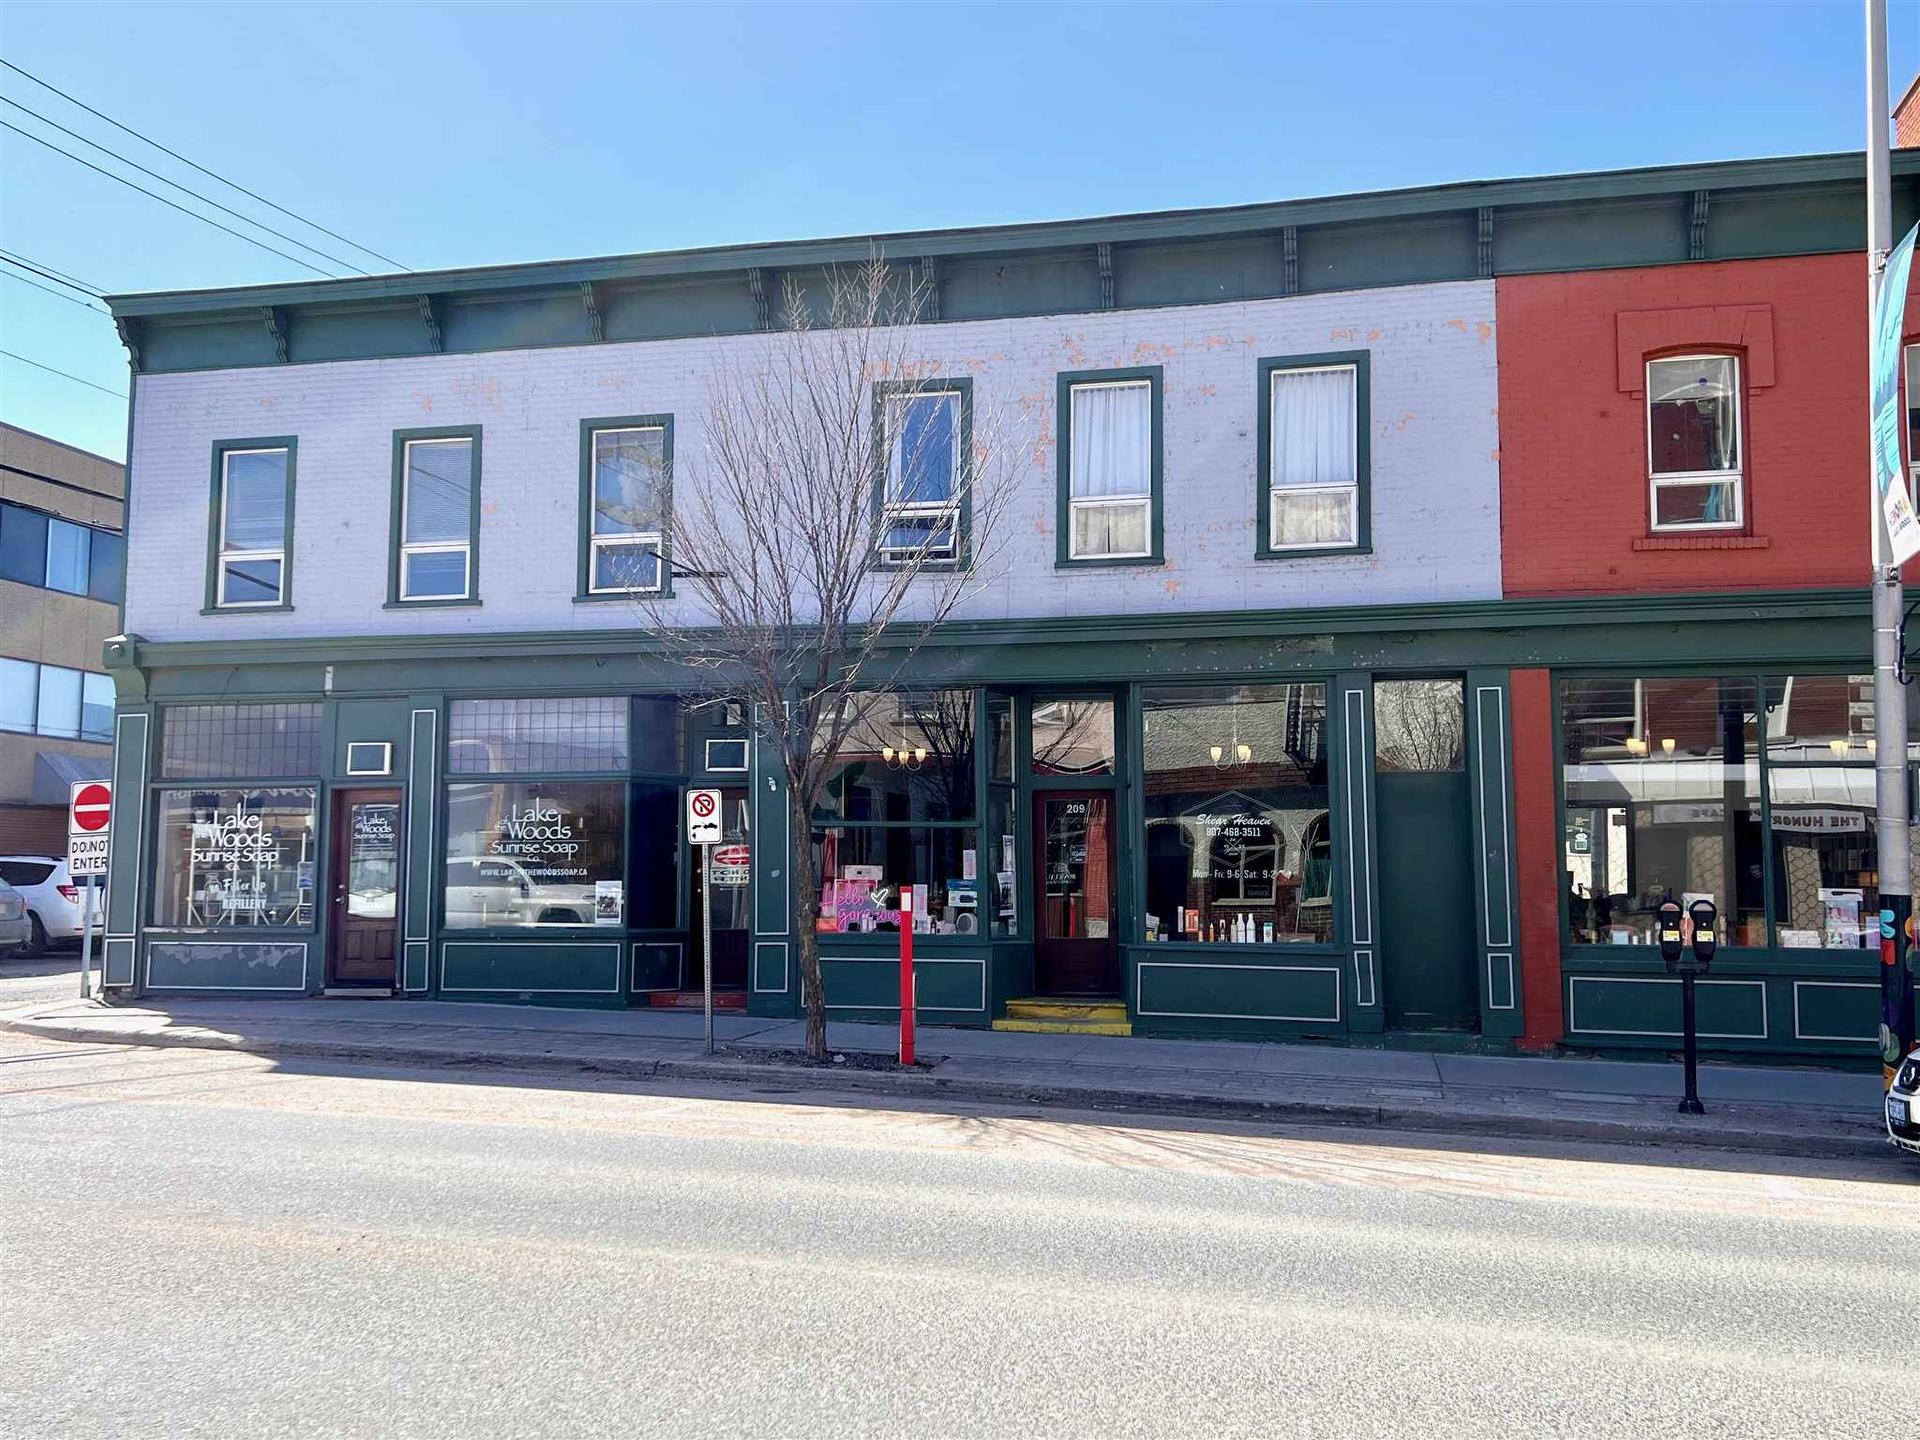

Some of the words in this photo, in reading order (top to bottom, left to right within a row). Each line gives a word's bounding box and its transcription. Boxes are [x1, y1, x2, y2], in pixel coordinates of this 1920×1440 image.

[213, 802, 260, 829] Lake
[513, 796, 559, 822] Lake
[1066, 804, 1086, 814] 209
[507, 814, 572, 840] Woods
[1230, 813, 1272, 826] Heaven
[209, 820, 273, 848] Woods
[1206, 827, 1261, 837] 807-468-3511
[72, 841, 87, 854] DO
[89, 840, 109, 853] NO
[490, 840, 541, 854] Sunrise
[541, 840, 579, 861] Soap
[73, 856, 108, 870] ENTER
[191, 847, 241, 862] Sunrise
[241, 848, 279, 870] Soap
[480, 868, 588, 877] WWW.LAKETHEWOODSSOAP.CA
[1226, 869, 1240, 879] 9-6
[838, 908, 901, 932] gorous
